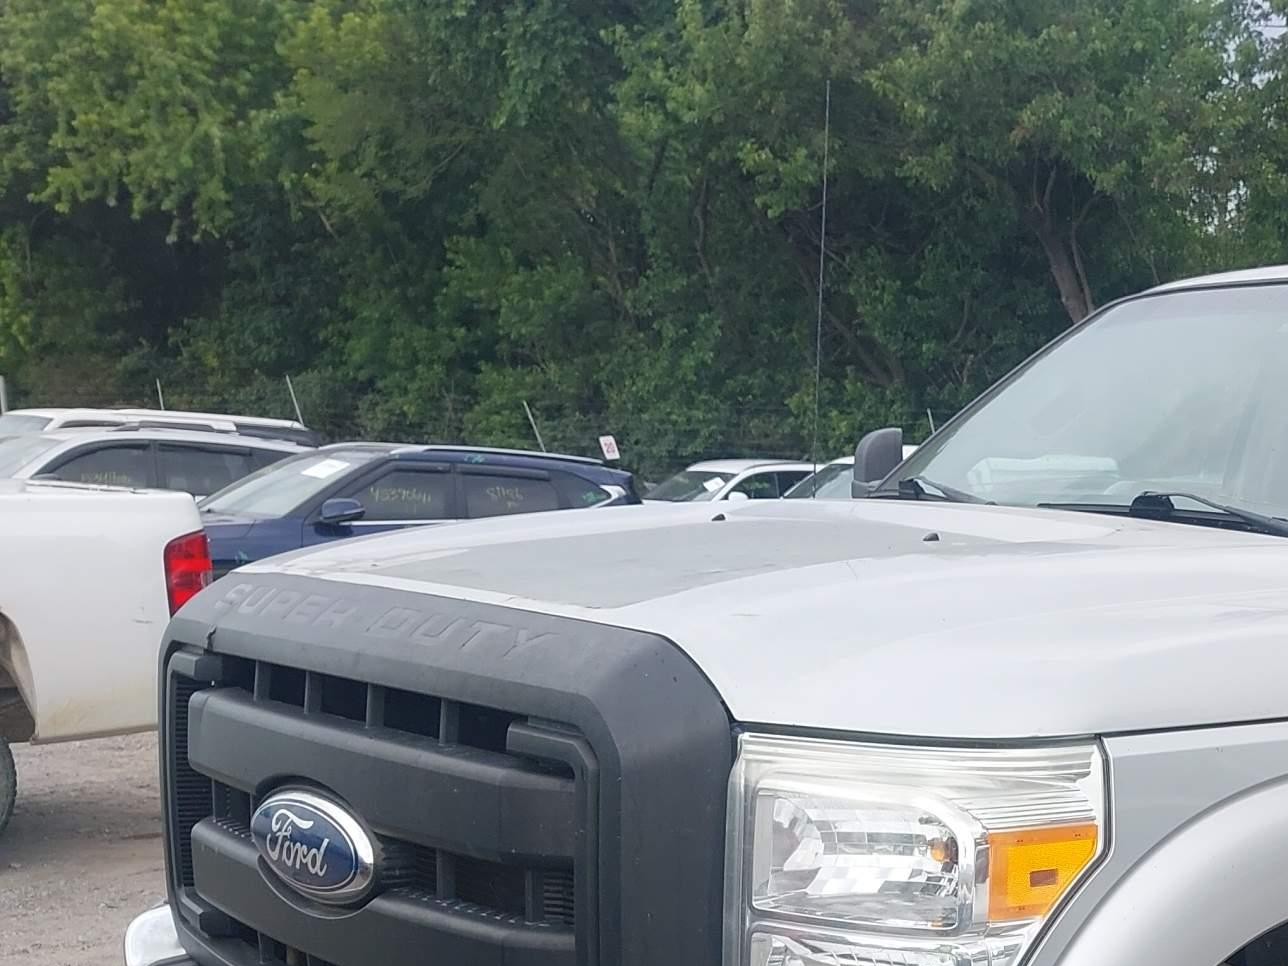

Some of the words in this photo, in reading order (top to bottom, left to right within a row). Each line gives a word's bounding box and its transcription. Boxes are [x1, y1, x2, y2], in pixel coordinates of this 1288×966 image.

[214, 582, 357, 629] SUPER
[365, 606, 560, 657] DUTY
[266, 808, 330, 877] Ford
